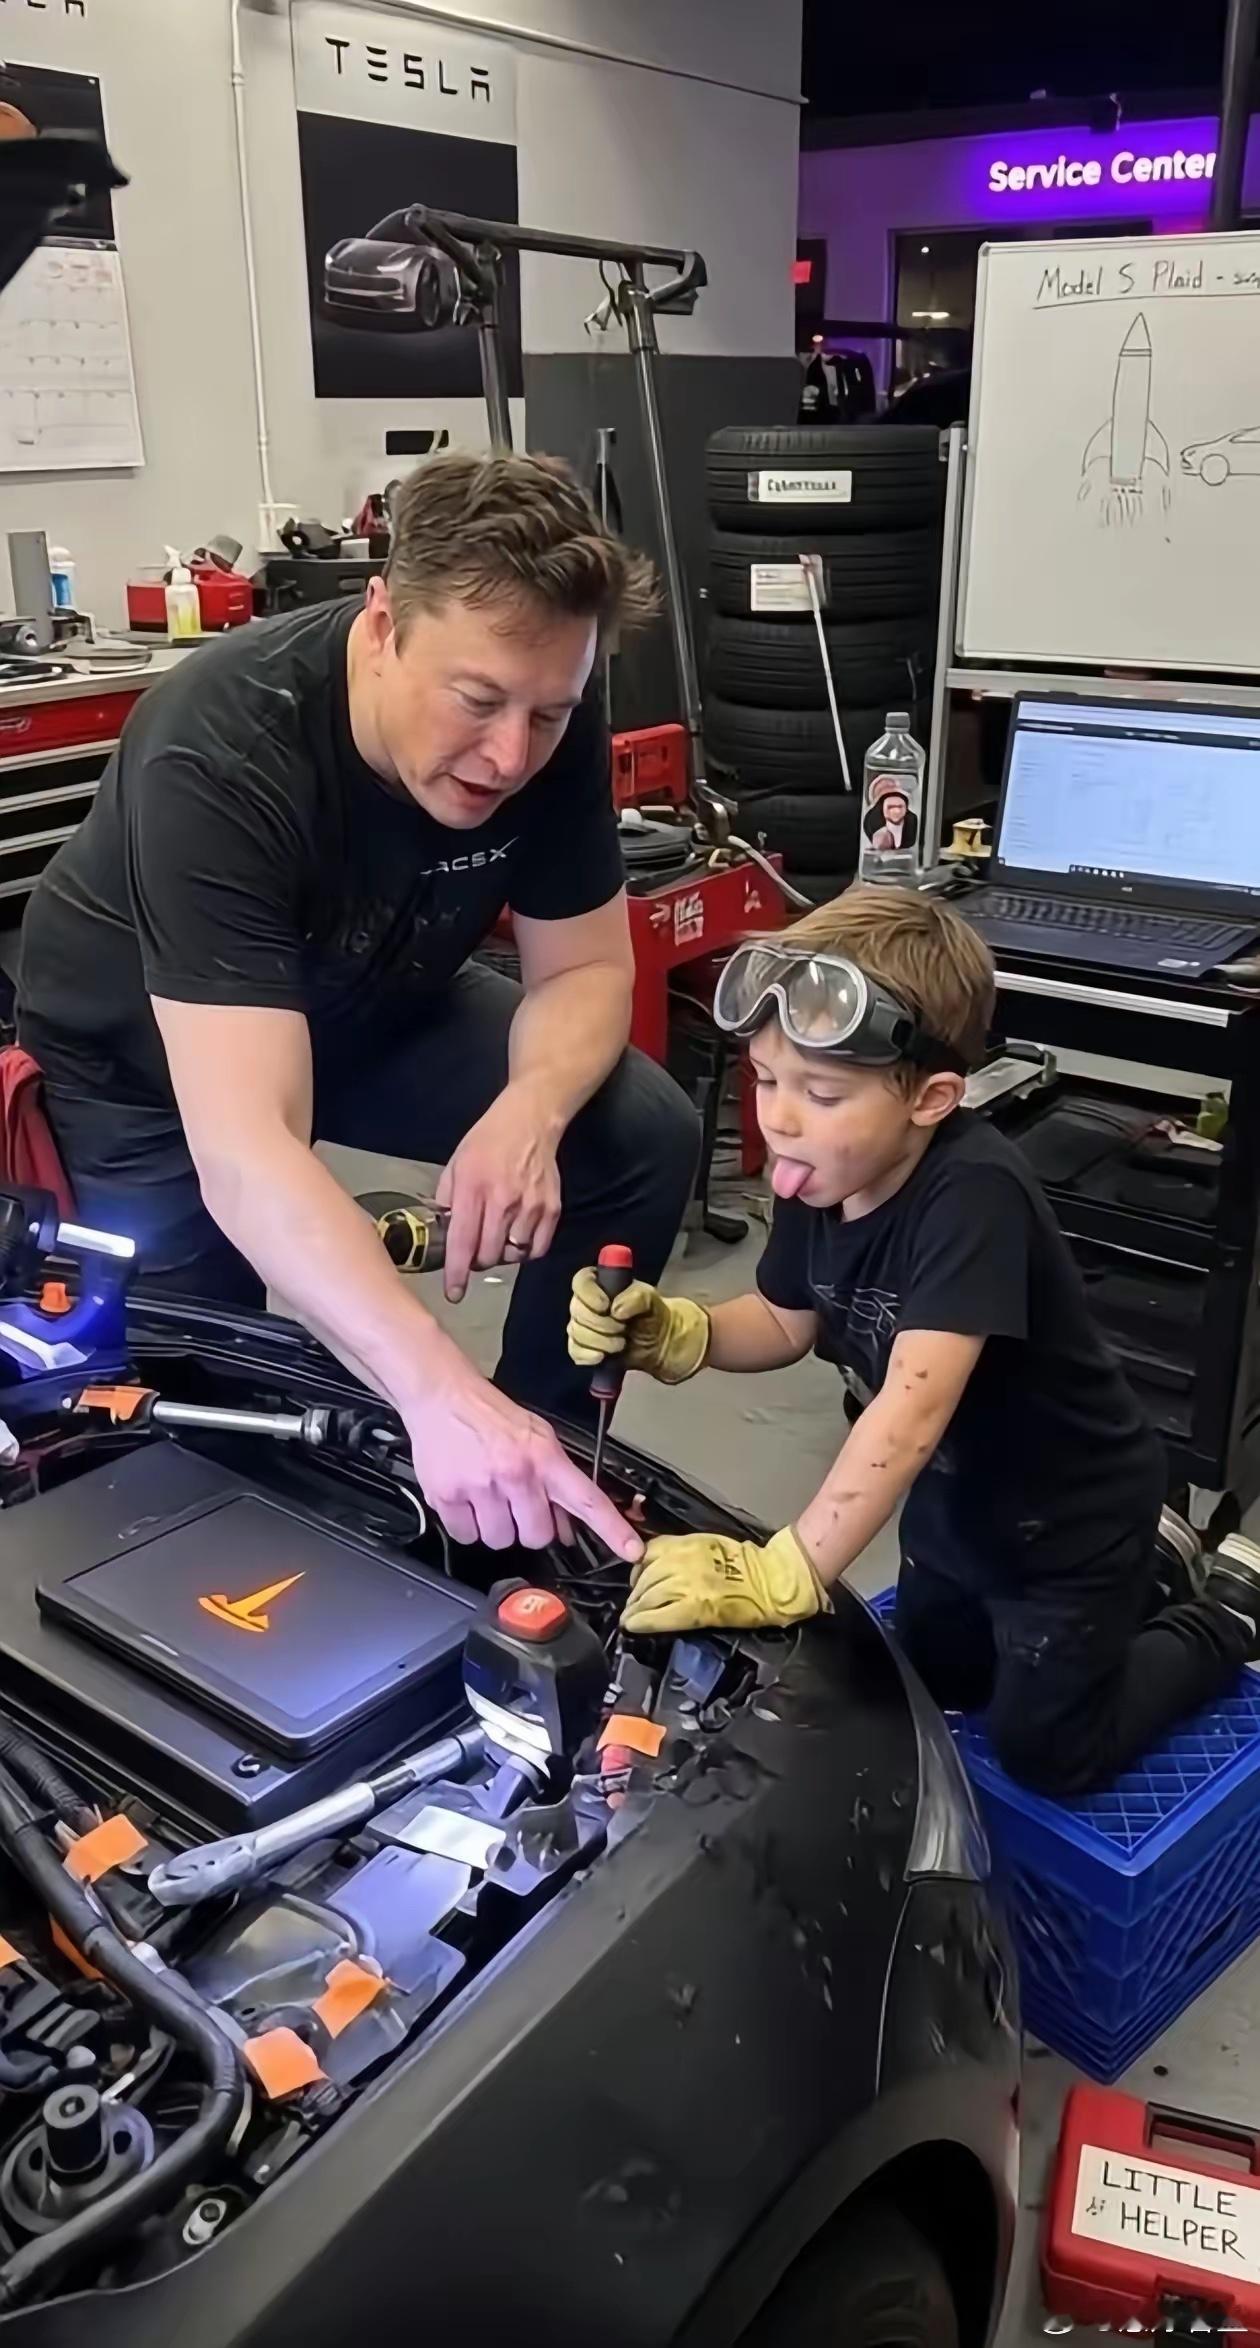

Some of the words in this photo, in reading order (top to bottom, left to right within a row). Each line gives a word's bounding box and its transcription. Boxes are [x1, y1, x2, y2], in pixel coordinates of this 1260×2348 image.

[325, 36, 490, 103] TESLA
[988, 155, 1102, 192] Service
[1037, 260, 1103, 300] Model
[1118, 262, 1135, 294] S
[1153, 260, 1203, 292] Plaid
[1102, 2161, 1237, 2218] LITTLE
[1121, 2201, 1246, 2260] HELPER
